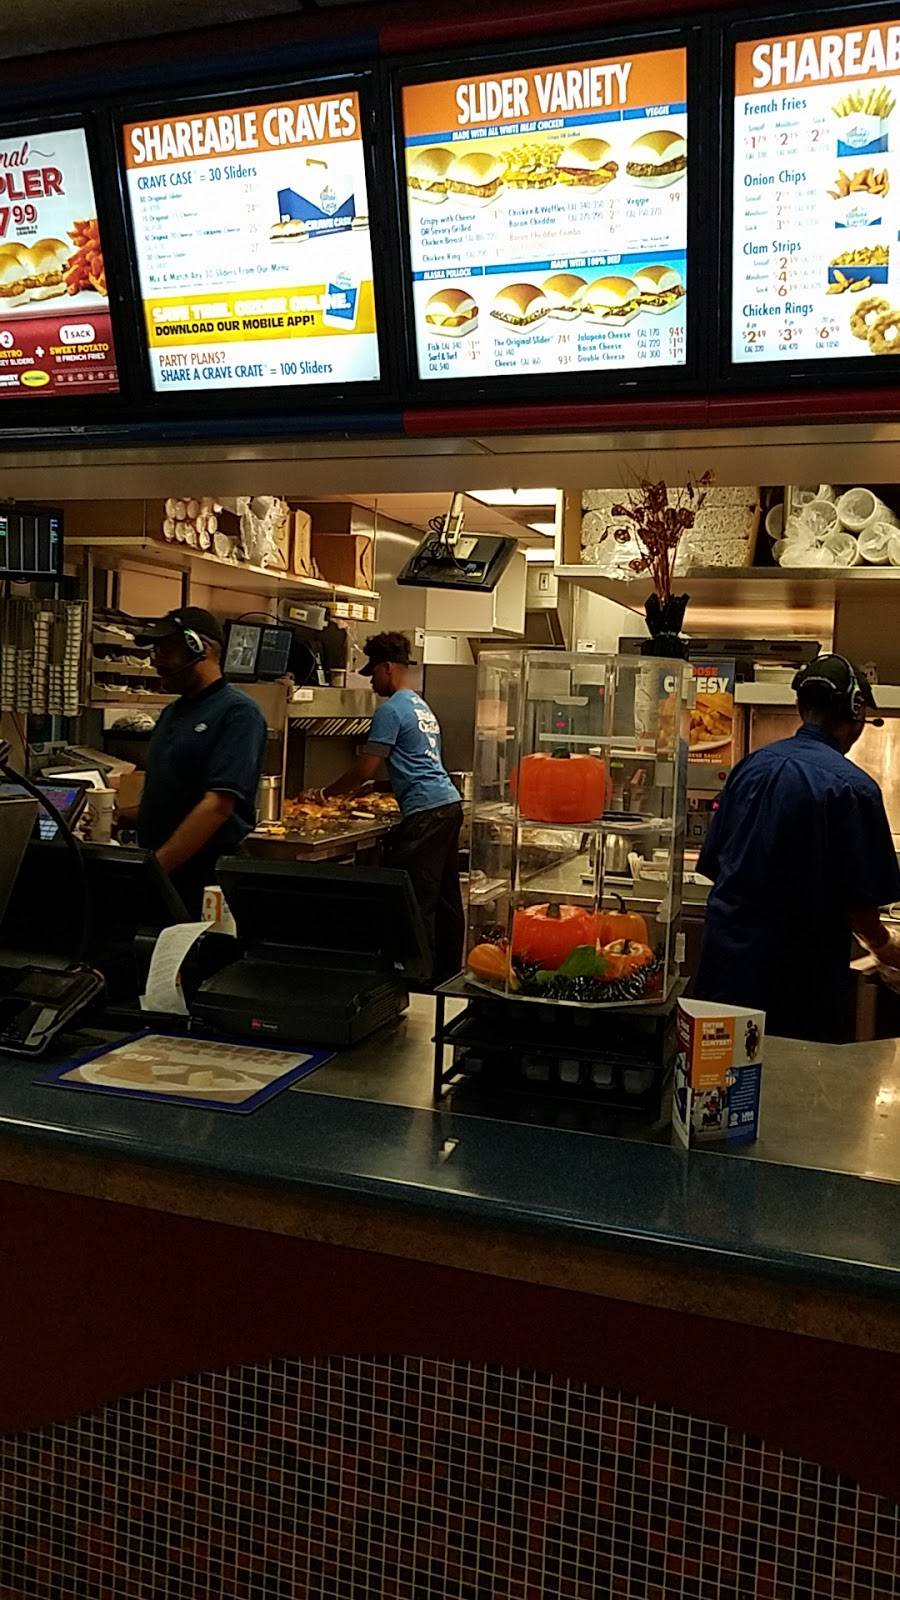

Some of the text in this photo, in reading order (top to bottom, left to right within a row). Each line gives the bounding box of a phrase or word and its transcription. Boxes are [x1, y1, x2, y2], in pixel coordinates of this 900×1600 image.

[752, 26, 900, 88] SHAREAB
[455, 61, 633, 125] SLIDER VARIETY
[645, 105, 670, 117] VEGGIE
[744, 97, 807, 116] French Fries
[130, 98, 356, 164] SHAREABLE CRAVES
[452, 129, 470, 141] MADE
[470, 127, 487, 140] WITH
[487, 126, 499, 137] ALL
[499, 124, 519, 136] WHITE
[537, 118, 564, 132] CHICKEN
[137, 172, 167, 190] CRAVE
[169, 170, 192, 186] CASE
[208, 167, 221, 182] 30
[223, 164, 257, 180] Sliders
[744, 169, 807, 187] Onion Chips
[626, 197, 649, 206] Veggie
[508, 207, 533, 216] Chicken
[541, 203, 565, 214] Waffles
[420, 217, 438, 227] Crispy
[455, 213, 476, 221] Cheese
[508, 216, 555, 228] Bacon Cheddar
[422, 236, 463, 246] Chicken Breast
[743, 240, 801, 256] Clam Strips
[422, 253, 445, 262] Chicken
[550, 259, 569, 269] MADE
[568, 257, 586, 268] WITH
[256, 264, 269, 274] Our
[271, 263, 289, 272] Menu
[423, 267, 472, 280] ALASKA POLLOCK
[743, 302, 814, 317] Chicken Rings
[155, 315, 315, 337] DOWNLOAD OUR MOBILE APP!
[3, 335, 9, 344] 2
[70, 330, 91, 338] SACK
[607, 330, 631, 339] Cheese
[637, 328, 647, 337] CAL
[427, 343, 440, 351] Fish
[494, 338, 505, 346] The
[505, 337, 532, 347] Original
[532, 336, 551, 344] Slider
[577, 343, 597, 352] Bacon
[598, 342, 622, 351] Cheese
[637, 339, 647, 348] CAL
[49, 343, 109, 355] SWEET POTATO
[87, 352, 105, 360] FRIES
[159, 351, 226, 368] PARTY PLANS?
[428, 353, 441, 361] Surf
[446, 351, 458, 360] Turf
[577, 353, 600, 363] Double
[602, 352, 625, 361] Cheese
[637, 350, 647, 359] CAL
[494, 359, 517, 368] Cheese
[160, 367, 191, 382] SHARE
[193, 367, 201, 380] A
[202, 365, 232, 380] CRAVE
[234, 364, 264, 377] CRATE
[280, 362, 297, 376] 100
[299, 360, 333, 374] Sliders
[663, 675, 729, 694] CESY
